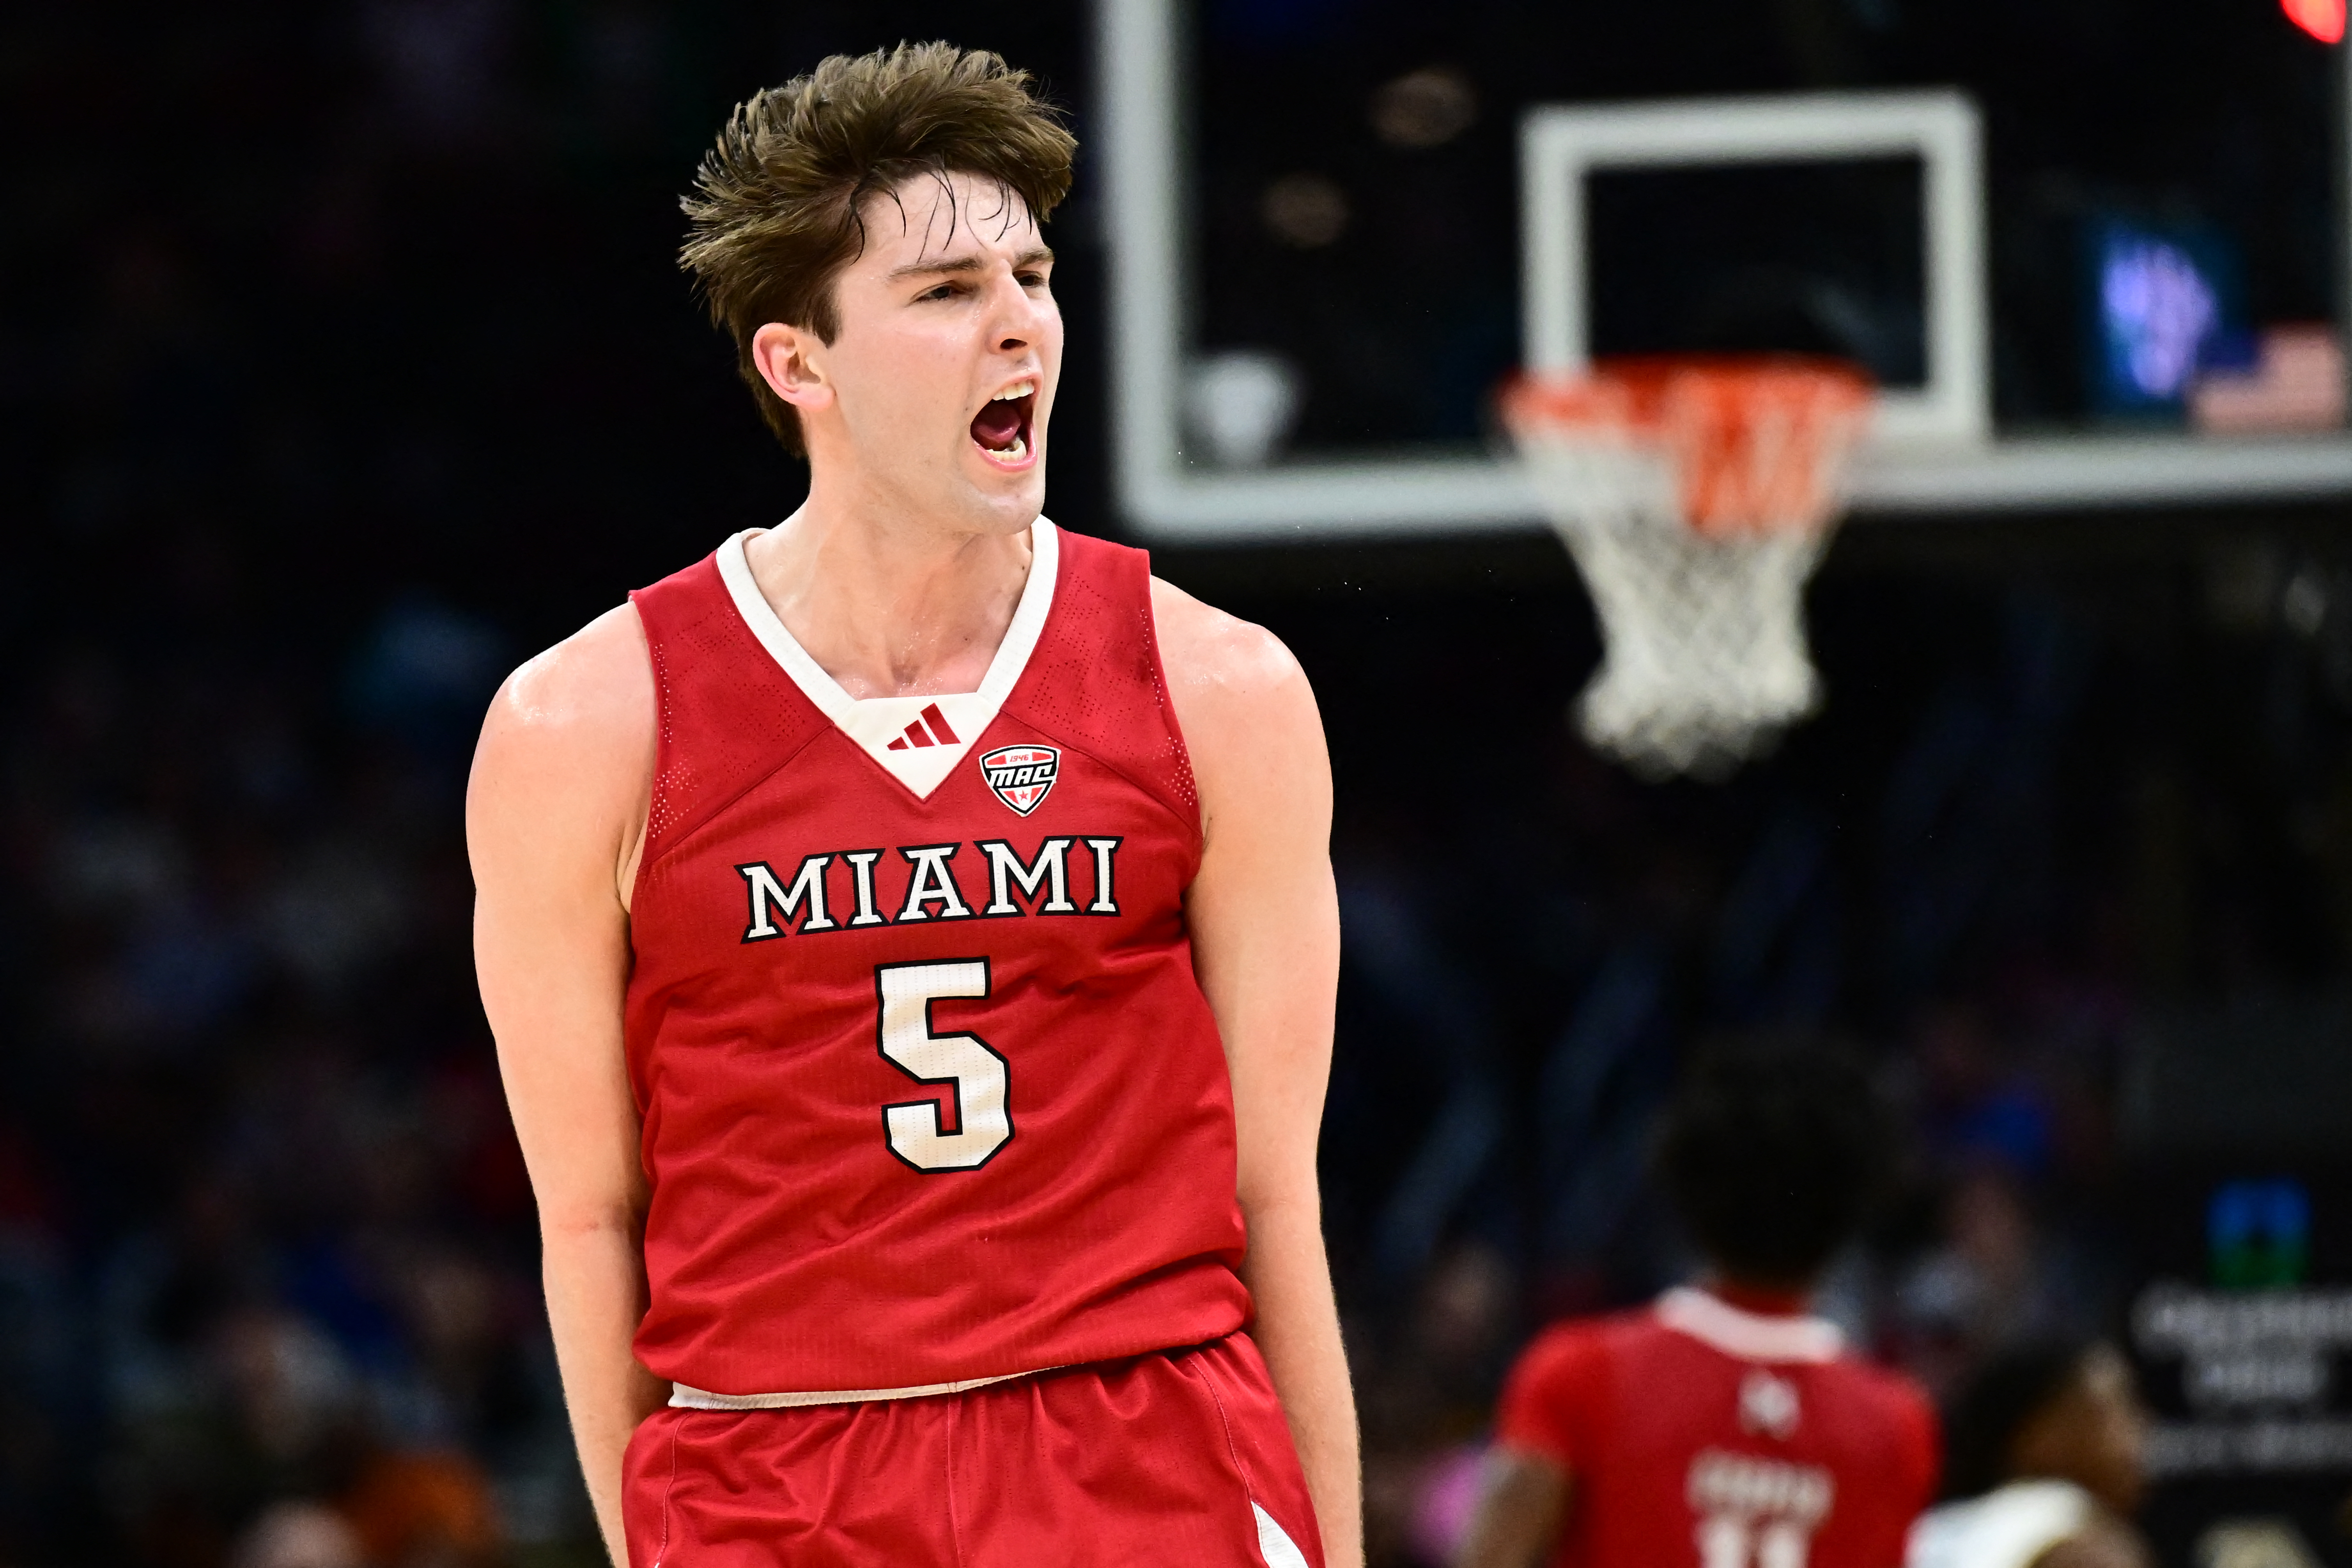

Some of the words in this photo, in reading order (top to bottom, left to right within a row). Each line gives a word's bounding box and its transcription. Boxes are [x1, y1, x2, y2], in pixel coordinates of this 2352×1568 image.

[989, 764, 1056, 787] MAC
[735, 836, 1124, 944] MIAMI
[874, 956, 1015, 1175] 5
